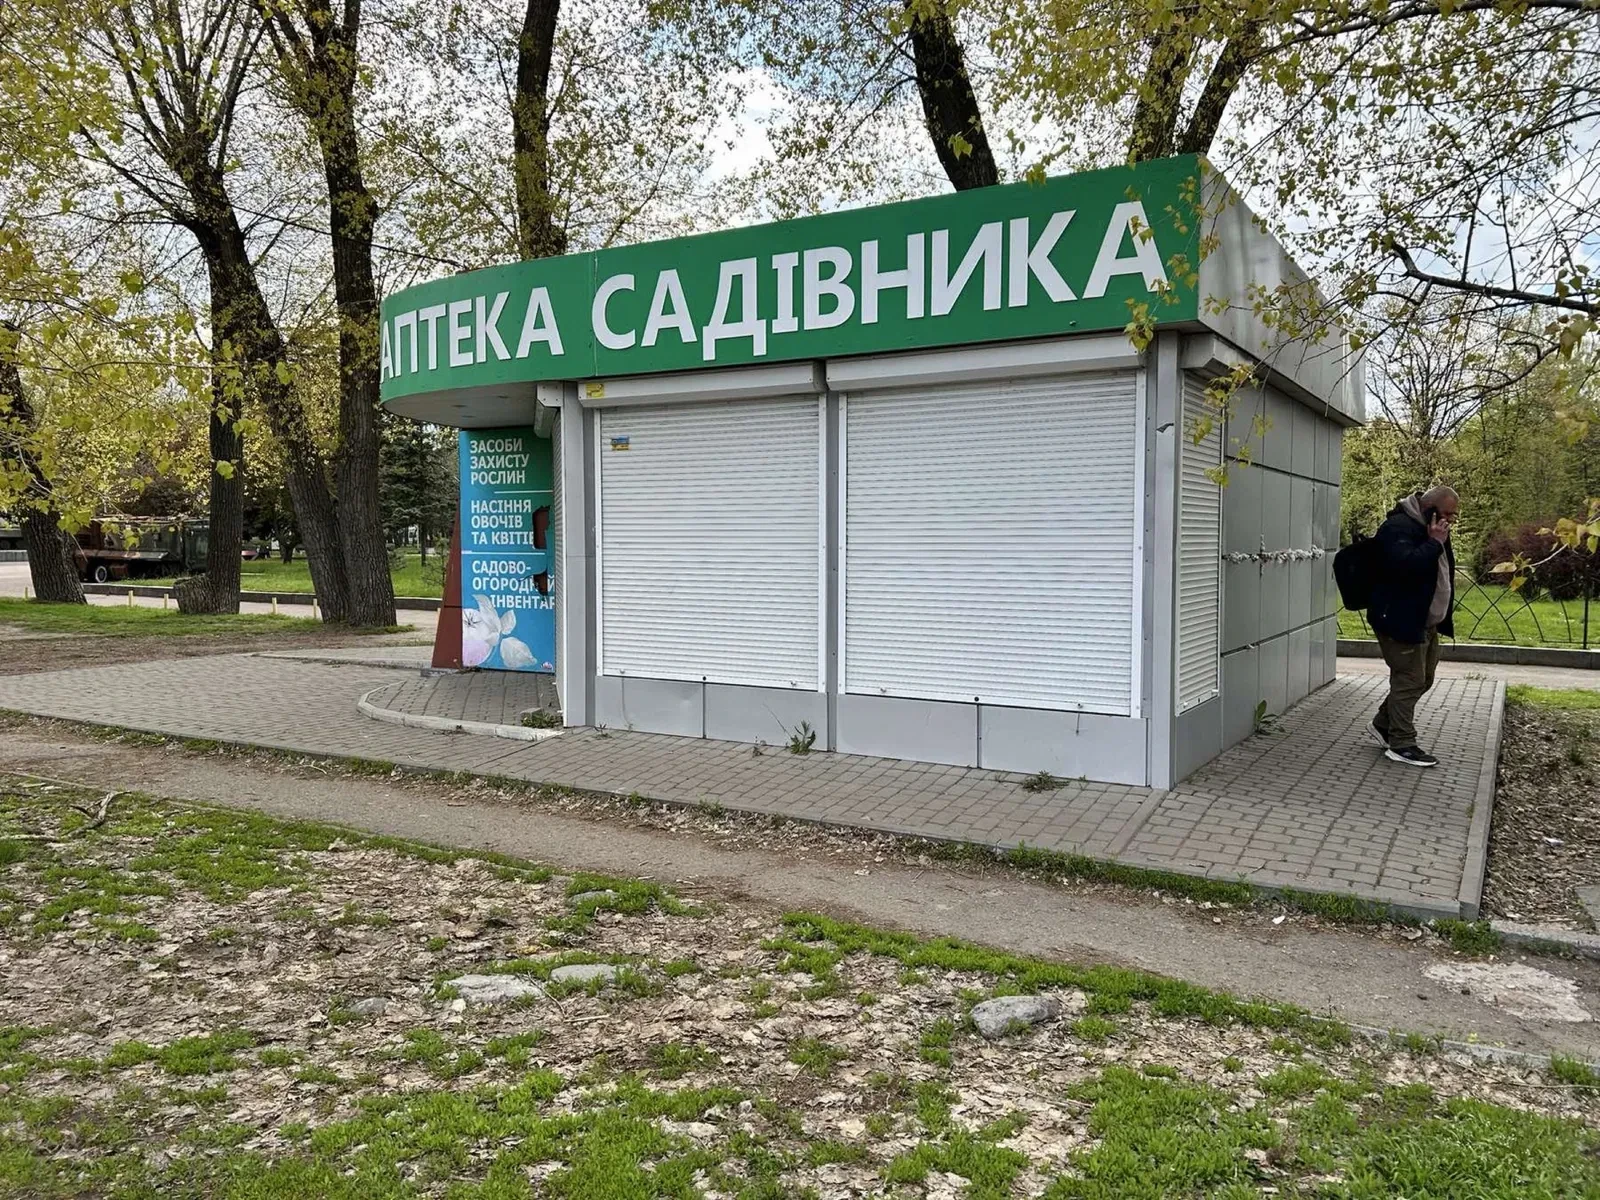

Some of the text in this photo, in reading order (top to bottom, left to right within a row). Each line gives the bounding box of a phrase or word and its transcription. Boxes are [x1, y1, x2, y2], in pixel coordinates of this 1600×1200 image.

[380, 200, 1168, 383] АПТЕКА САДІВНИКА
[469, 438, 523, 454] ЗАСОБИ
[470, 453, 530, 470] ЗАХИСТУ
[470, 470, 526, 485] РОСЛИН
[470, 499, 532, 514] НАСІННЯ
[471, 514, 523, 529] ОВОЧІВ
[471, 531, 488, 545] ТА
[472, 560, 531, 576] САДОВО-
